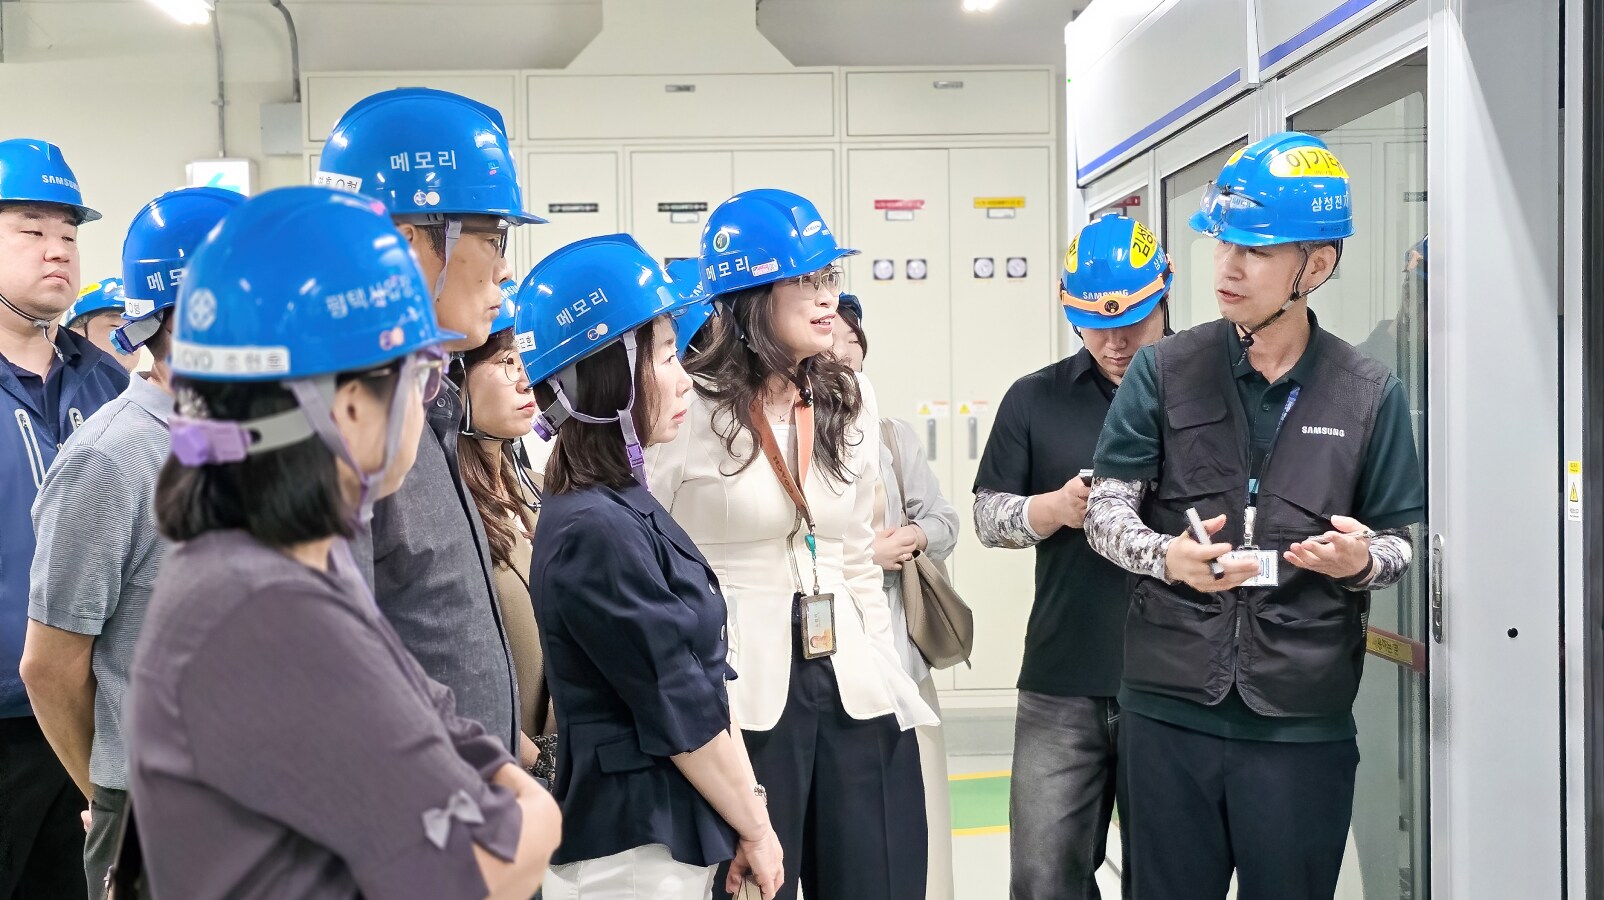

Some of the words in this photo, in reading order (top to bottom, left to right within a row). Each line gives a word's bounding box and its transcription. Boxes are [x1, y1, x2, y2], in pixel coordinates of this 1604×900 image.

[390, 150, 457, 172] 메모리
[705, 255, 750, 281] 메모리
[146, 269, 187, 292] 메모
[556, 287, 608, 327] 메모리
[1301, 425, 1345, 437] SAMSUNG
[773, 455, 794, 494] COACH
